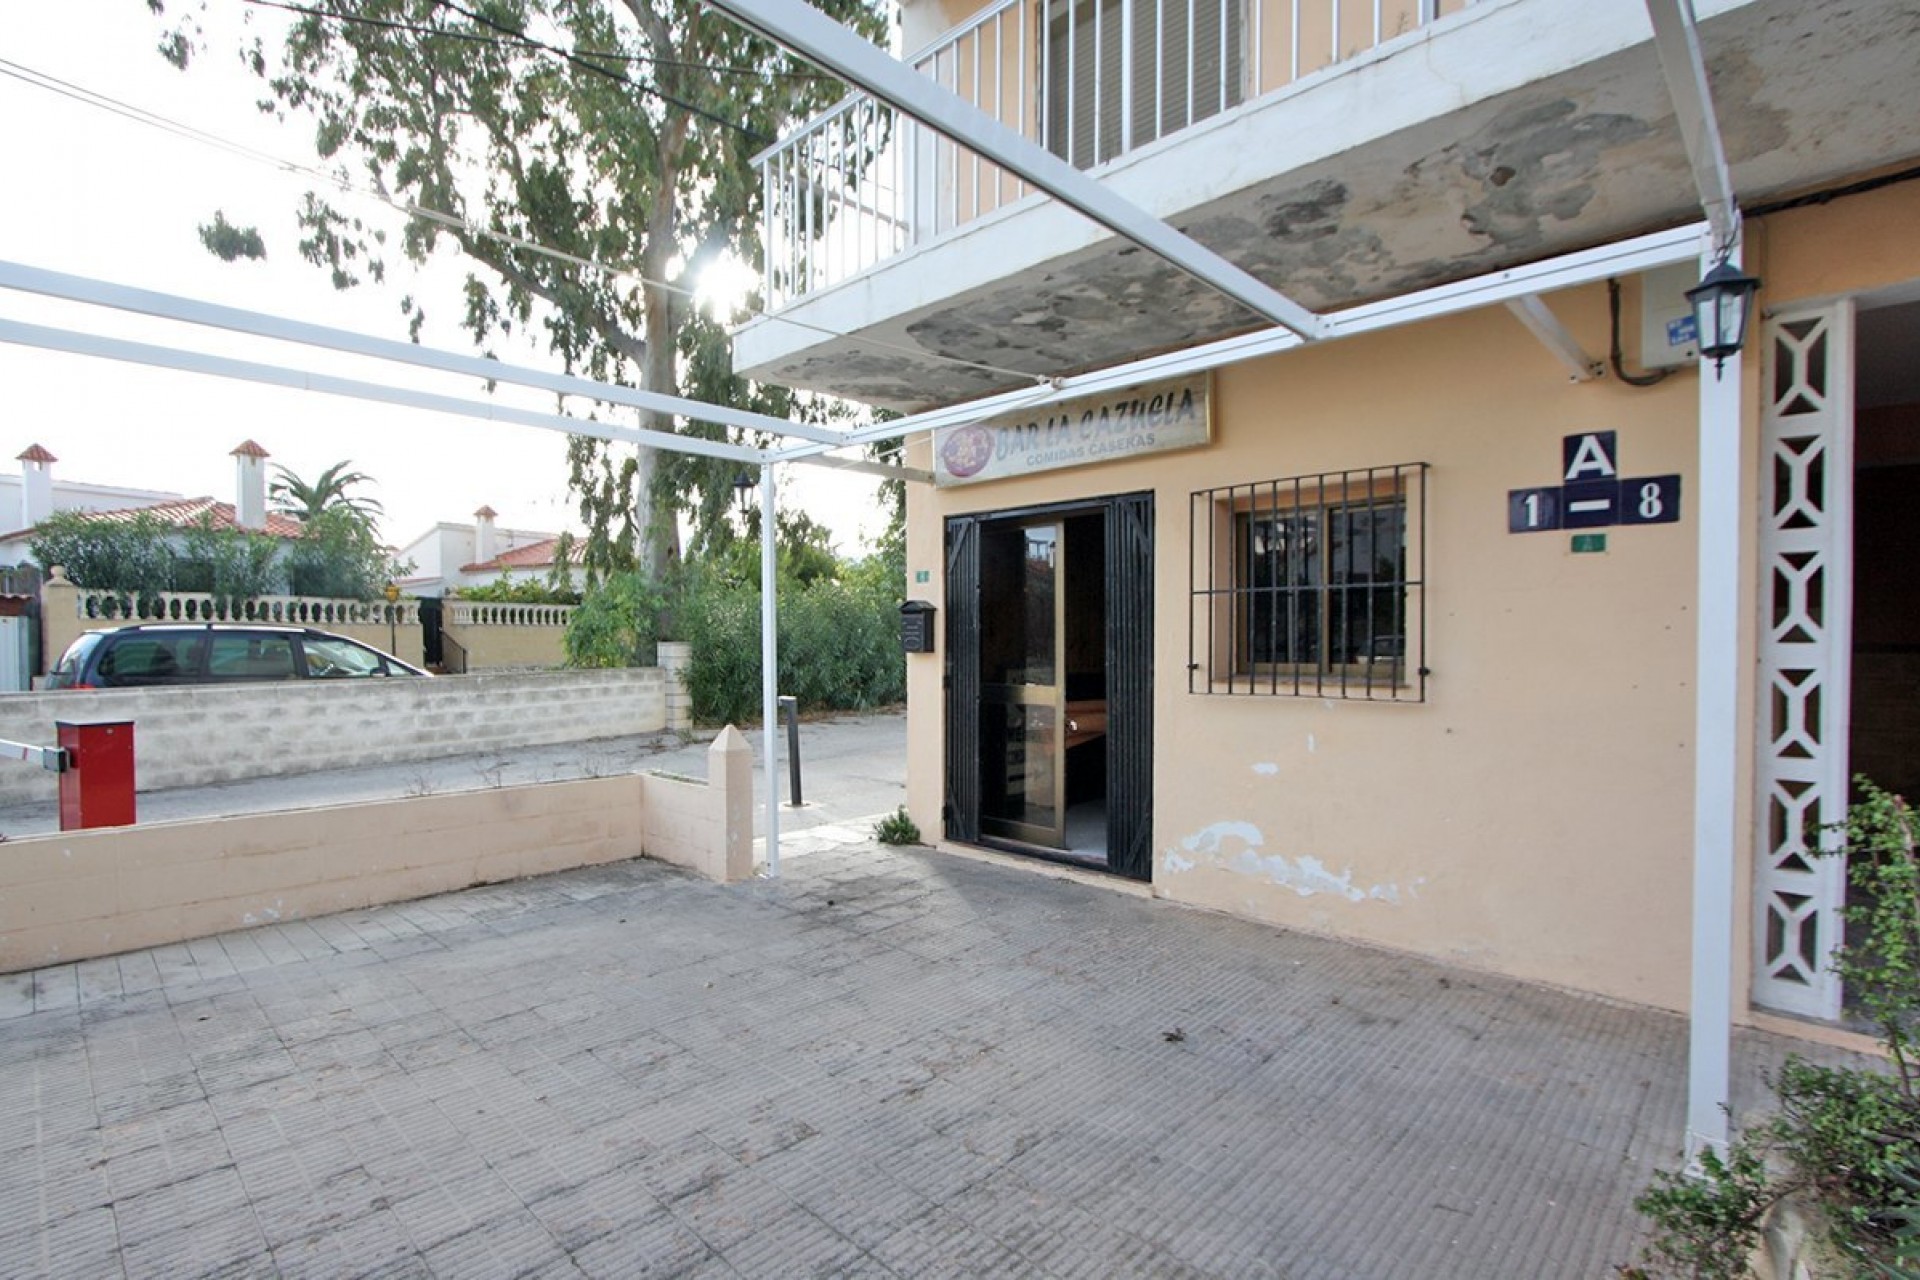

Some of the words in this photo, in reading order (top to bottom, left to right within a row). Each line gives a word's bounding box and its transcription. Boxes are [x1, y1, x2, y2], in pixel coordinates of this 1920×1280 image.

[996, 421, 1040, 461] BAR
[1045, 413, 1073, 447] LA
[1080, 387, 1196, 438] CAZUELA
[1026, 446, 1085, 466] COMIDAS
[1565, 434, 1615, 479] A
[1525, 493, 1539, 527] 1
[1638, 482, 1663, 519] 8
